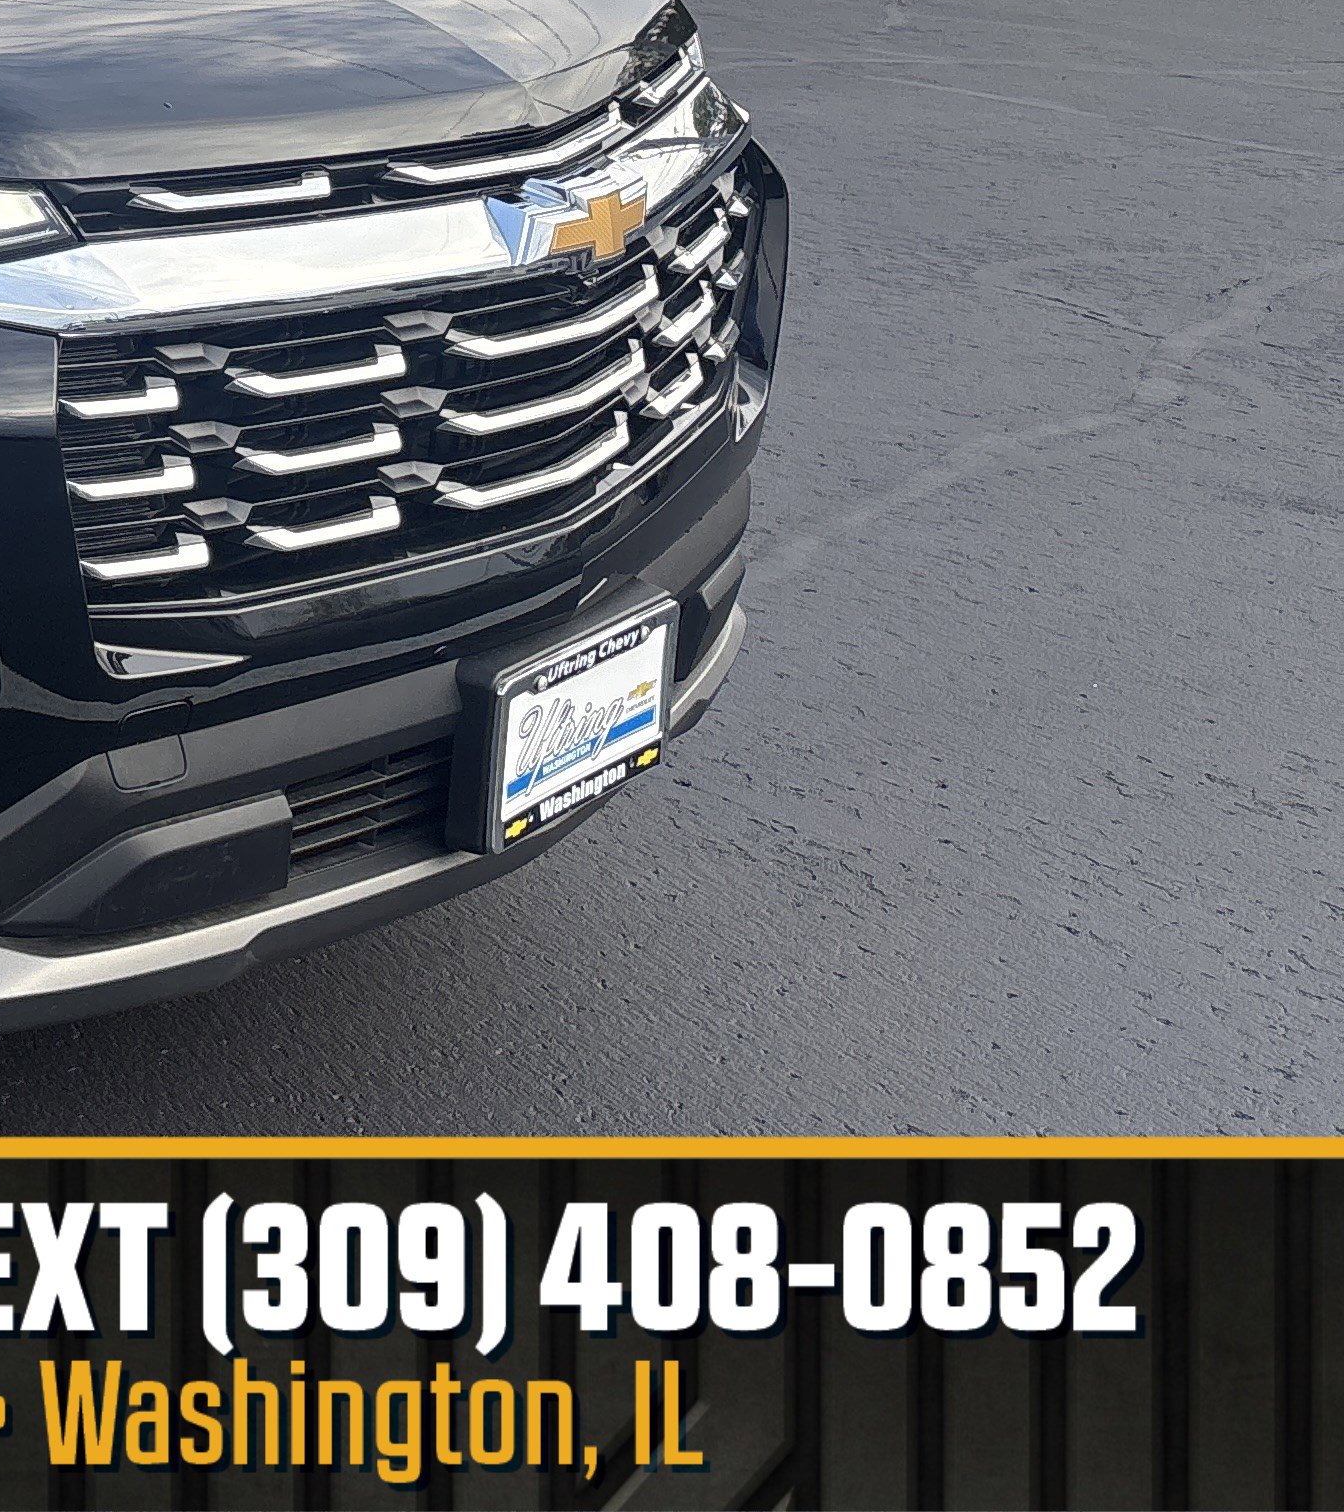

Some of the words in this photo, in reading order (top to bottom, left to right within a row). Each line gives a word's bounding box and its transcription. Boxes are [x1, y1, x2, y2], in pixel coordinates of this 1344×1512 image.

[547, 651, 596, 682] Uftring
[599, 631, 640, 659] Chevy
[516, 697, 624, 797] Uftring
[539, 761, 627, 822] Washington
